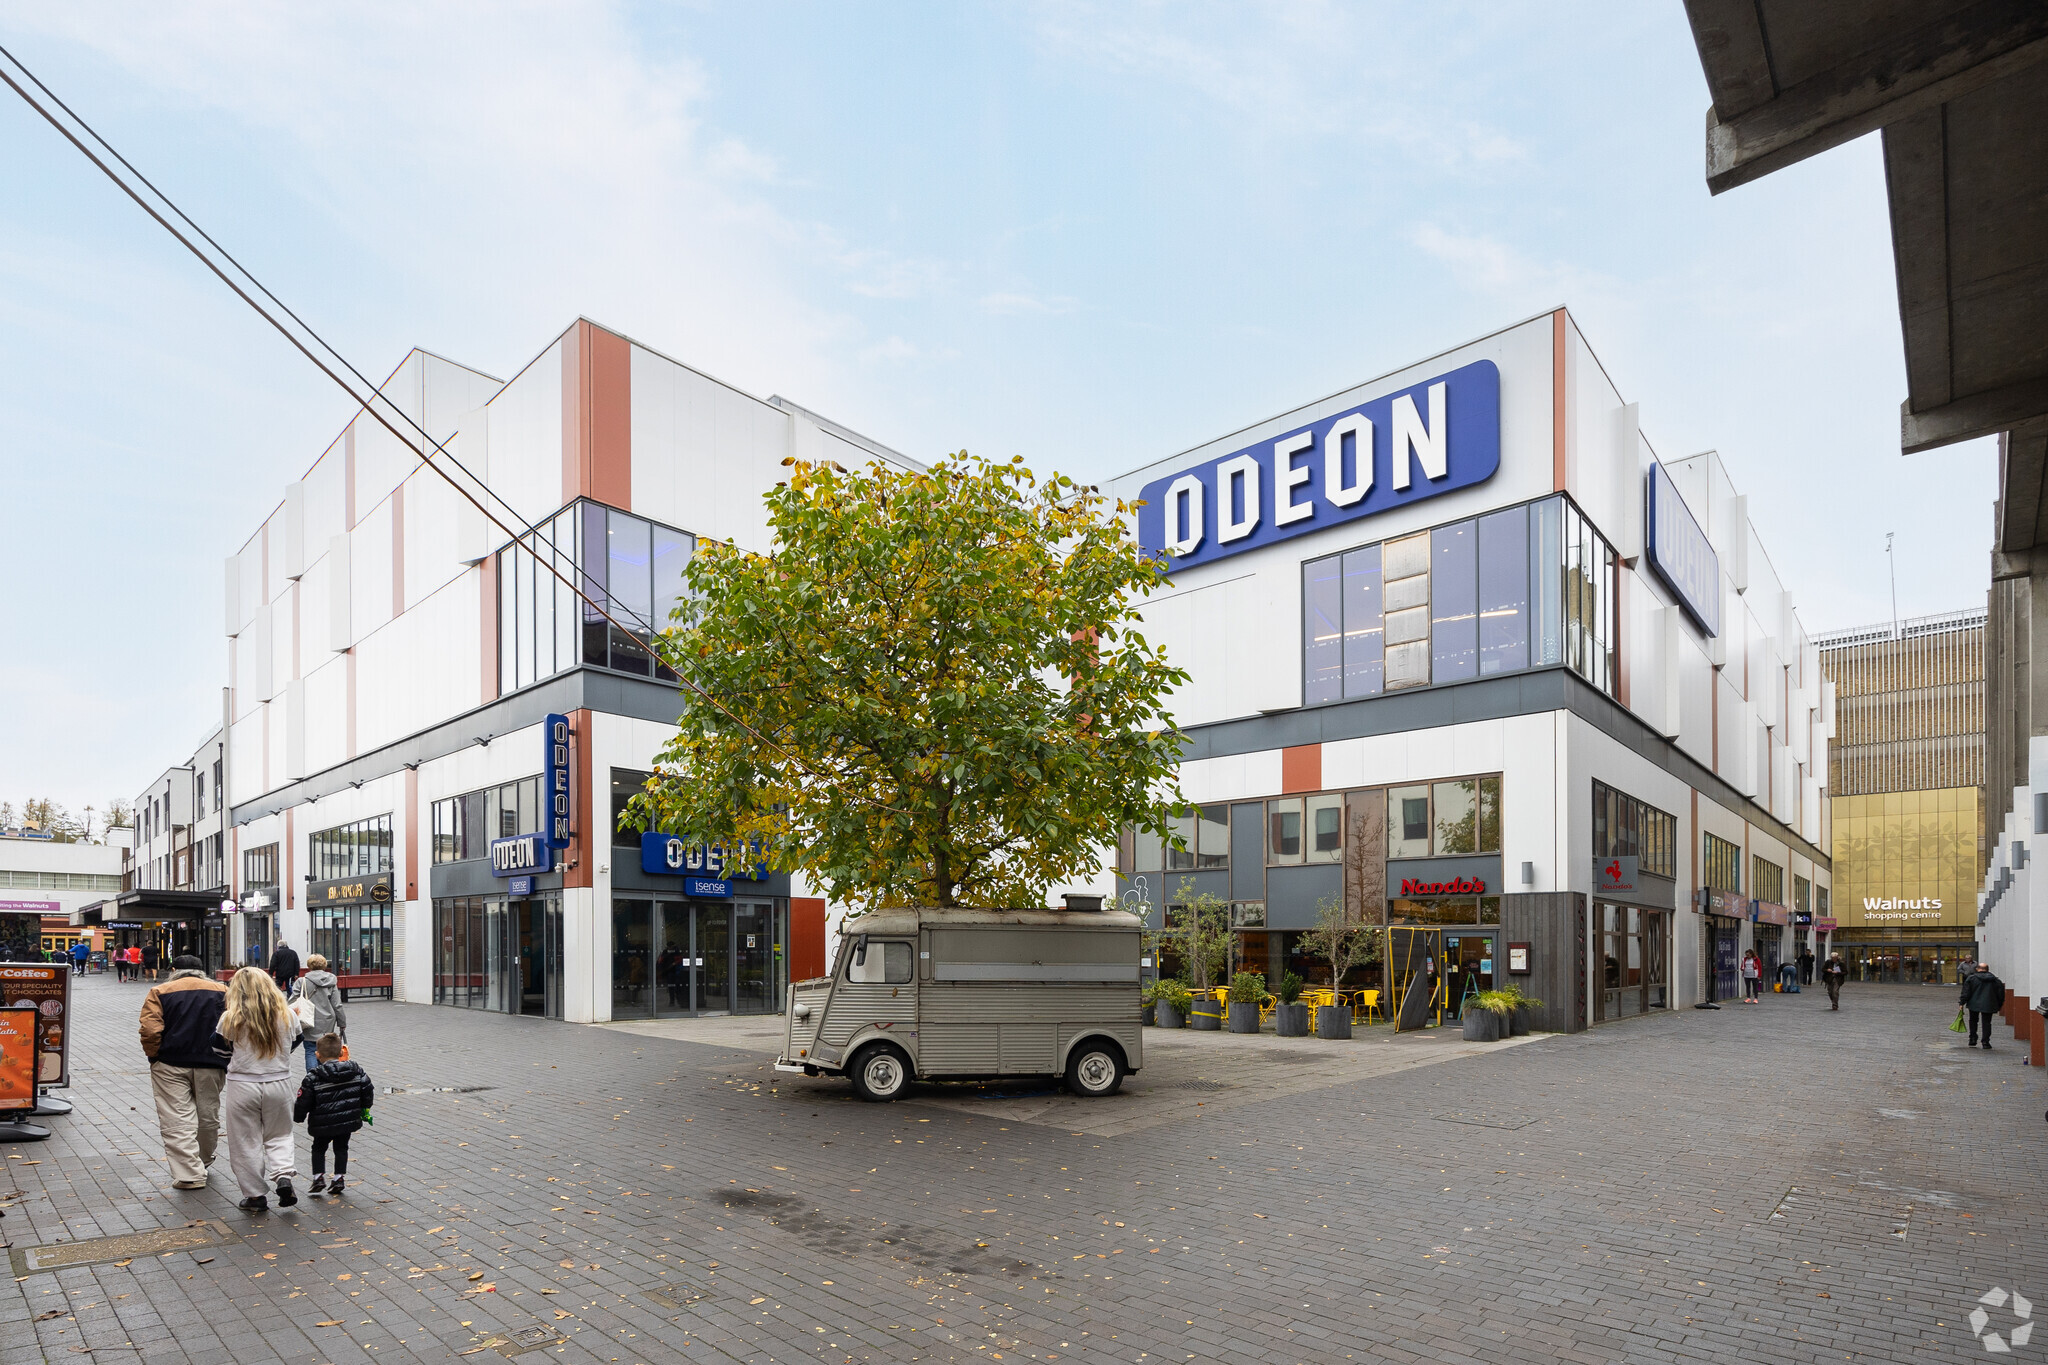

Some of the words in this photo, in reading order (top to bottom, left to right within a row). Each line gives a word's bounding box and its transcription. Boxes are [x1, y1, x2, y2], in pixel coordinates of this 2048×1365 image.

[1164, 381, 1448, 557] ODEON
[1664, 485, 1714, 622] ODEON
[554, 722, 568, 839] ODEON
[493, 837, 535, 871] ODEON
[695, 880, 726, 892] isense
[1400, 876, 1485, 895] Nando's
[1863, 897, 1943, 911] Walnuts
[1864, 912, 1908, 921] shopping
